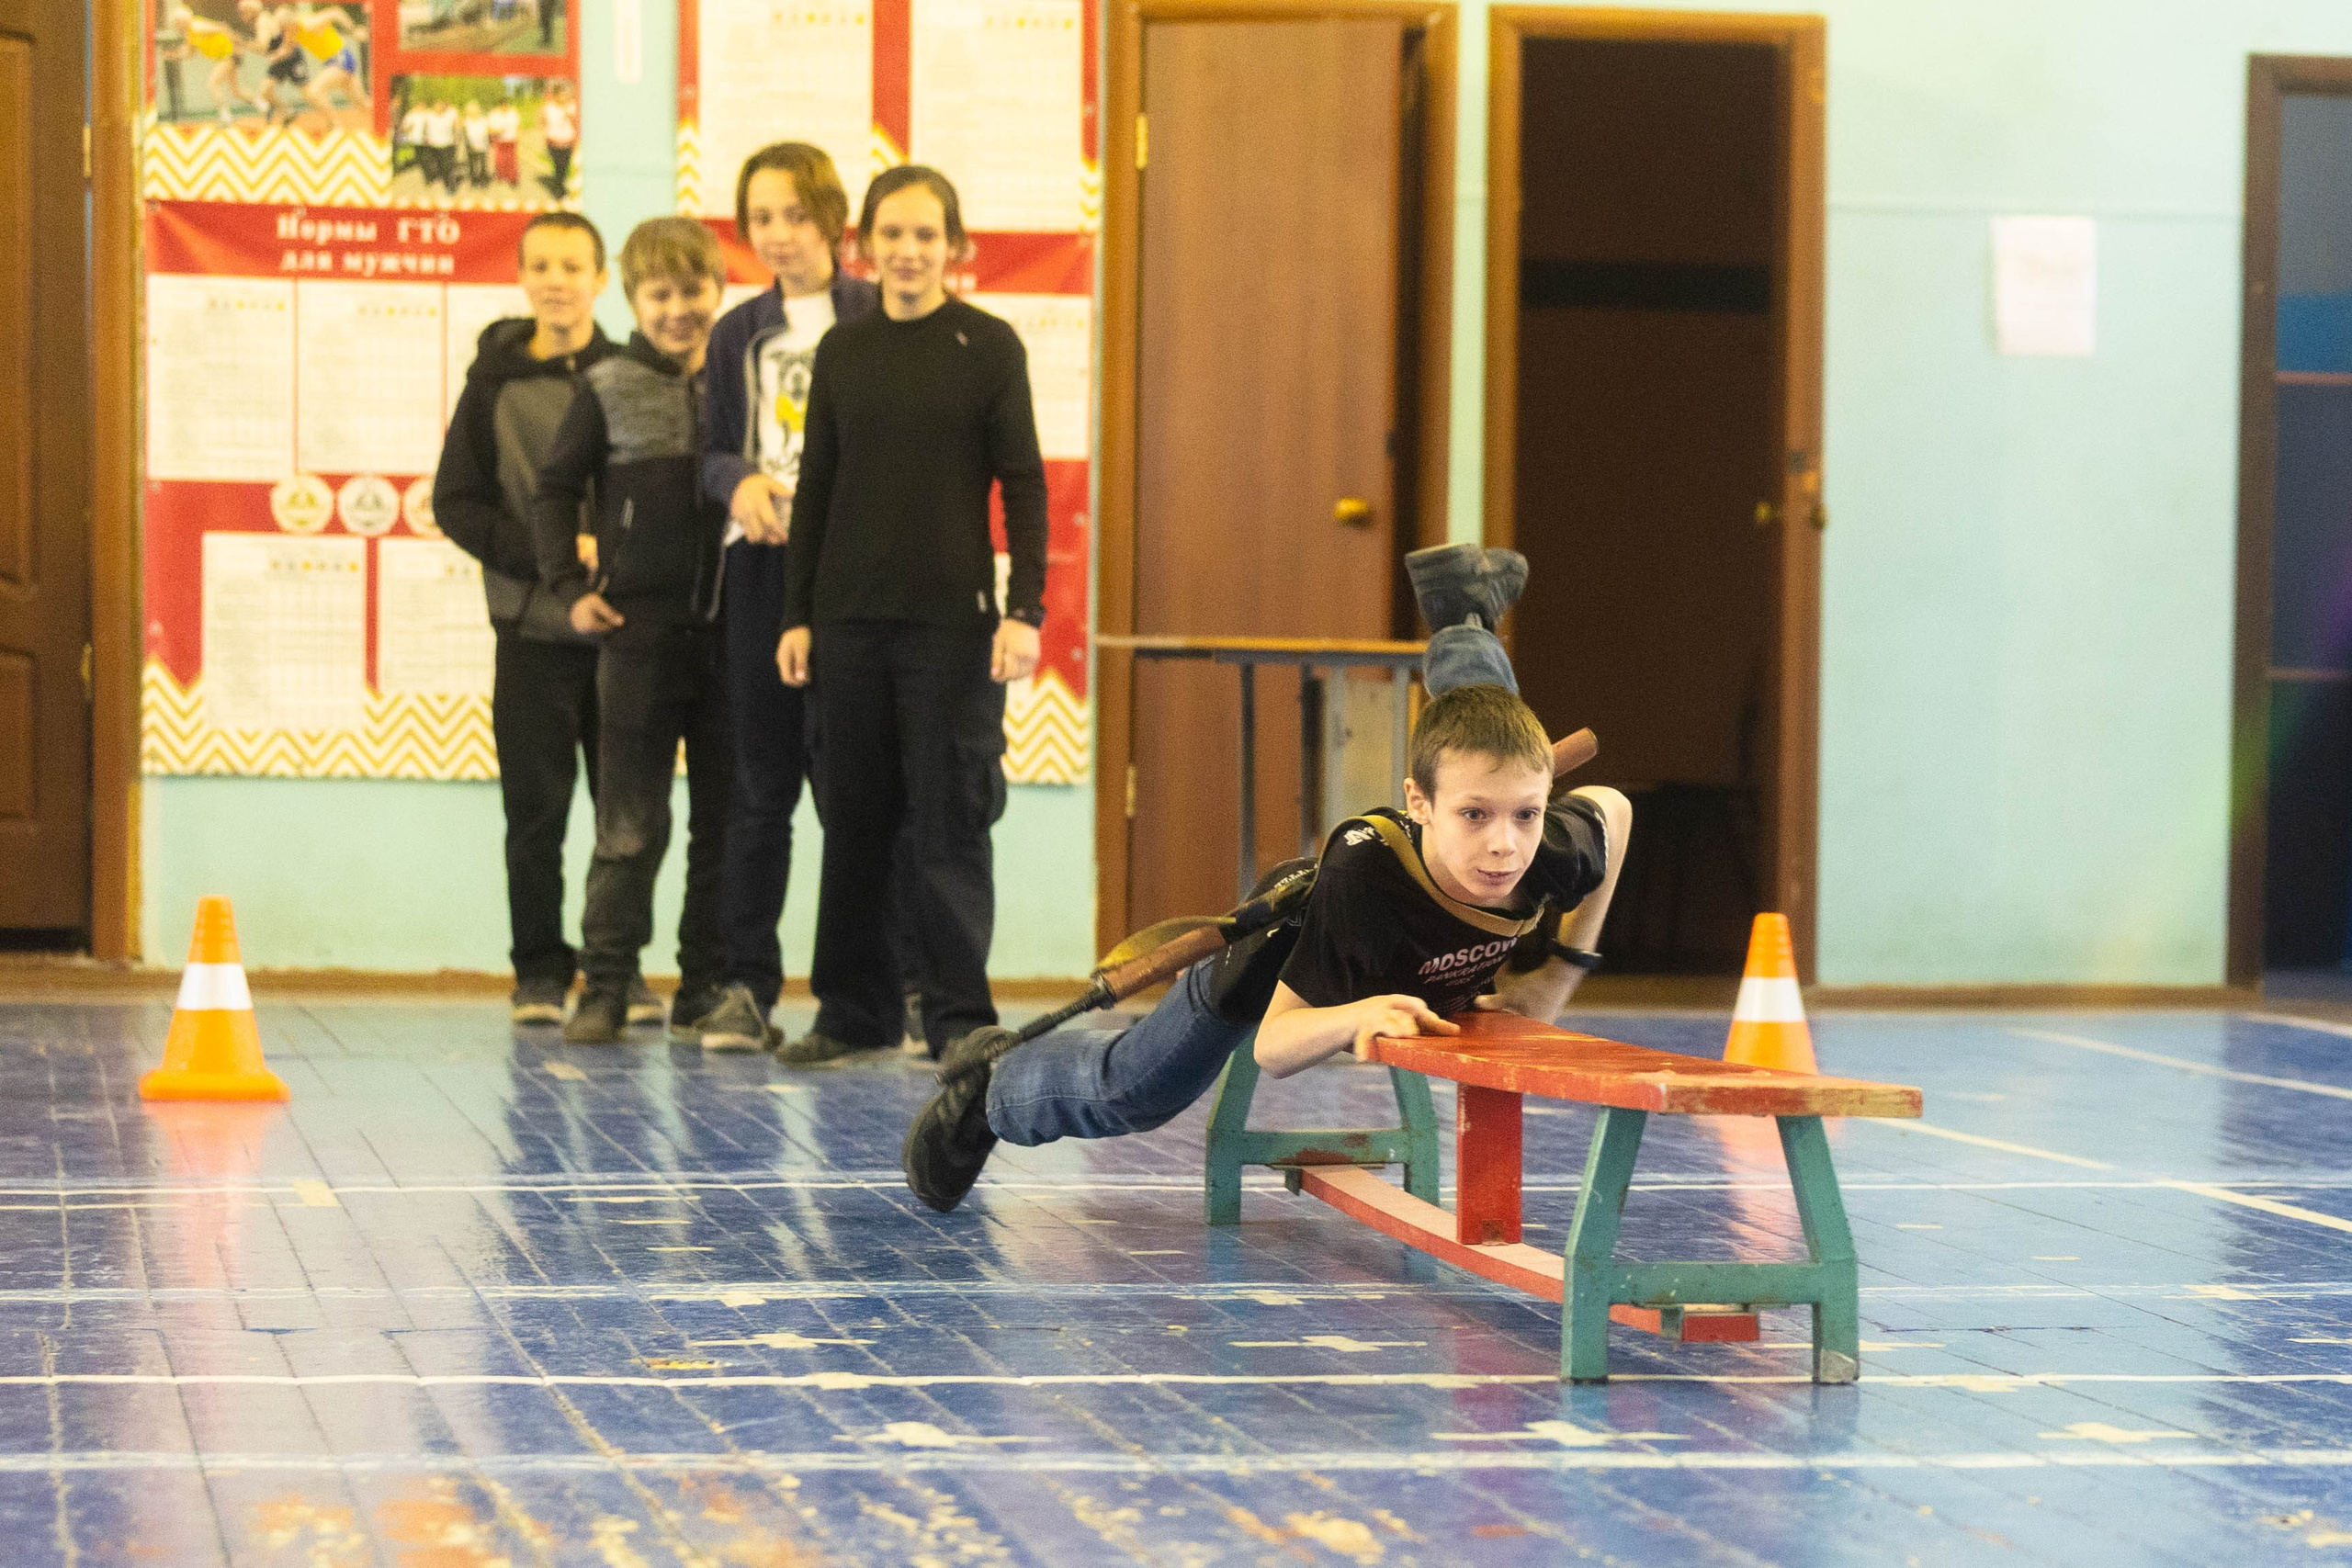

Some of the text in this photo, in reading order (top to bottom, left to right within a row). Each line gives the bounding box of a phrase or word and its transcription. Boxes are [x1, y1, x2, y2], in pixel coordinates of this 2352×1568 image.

[277, 213, 460, 245] Нормы ГТО
[280, 250, 455, 277] для мужчин
[1418, 936, 1519, 975] MOSCOW
